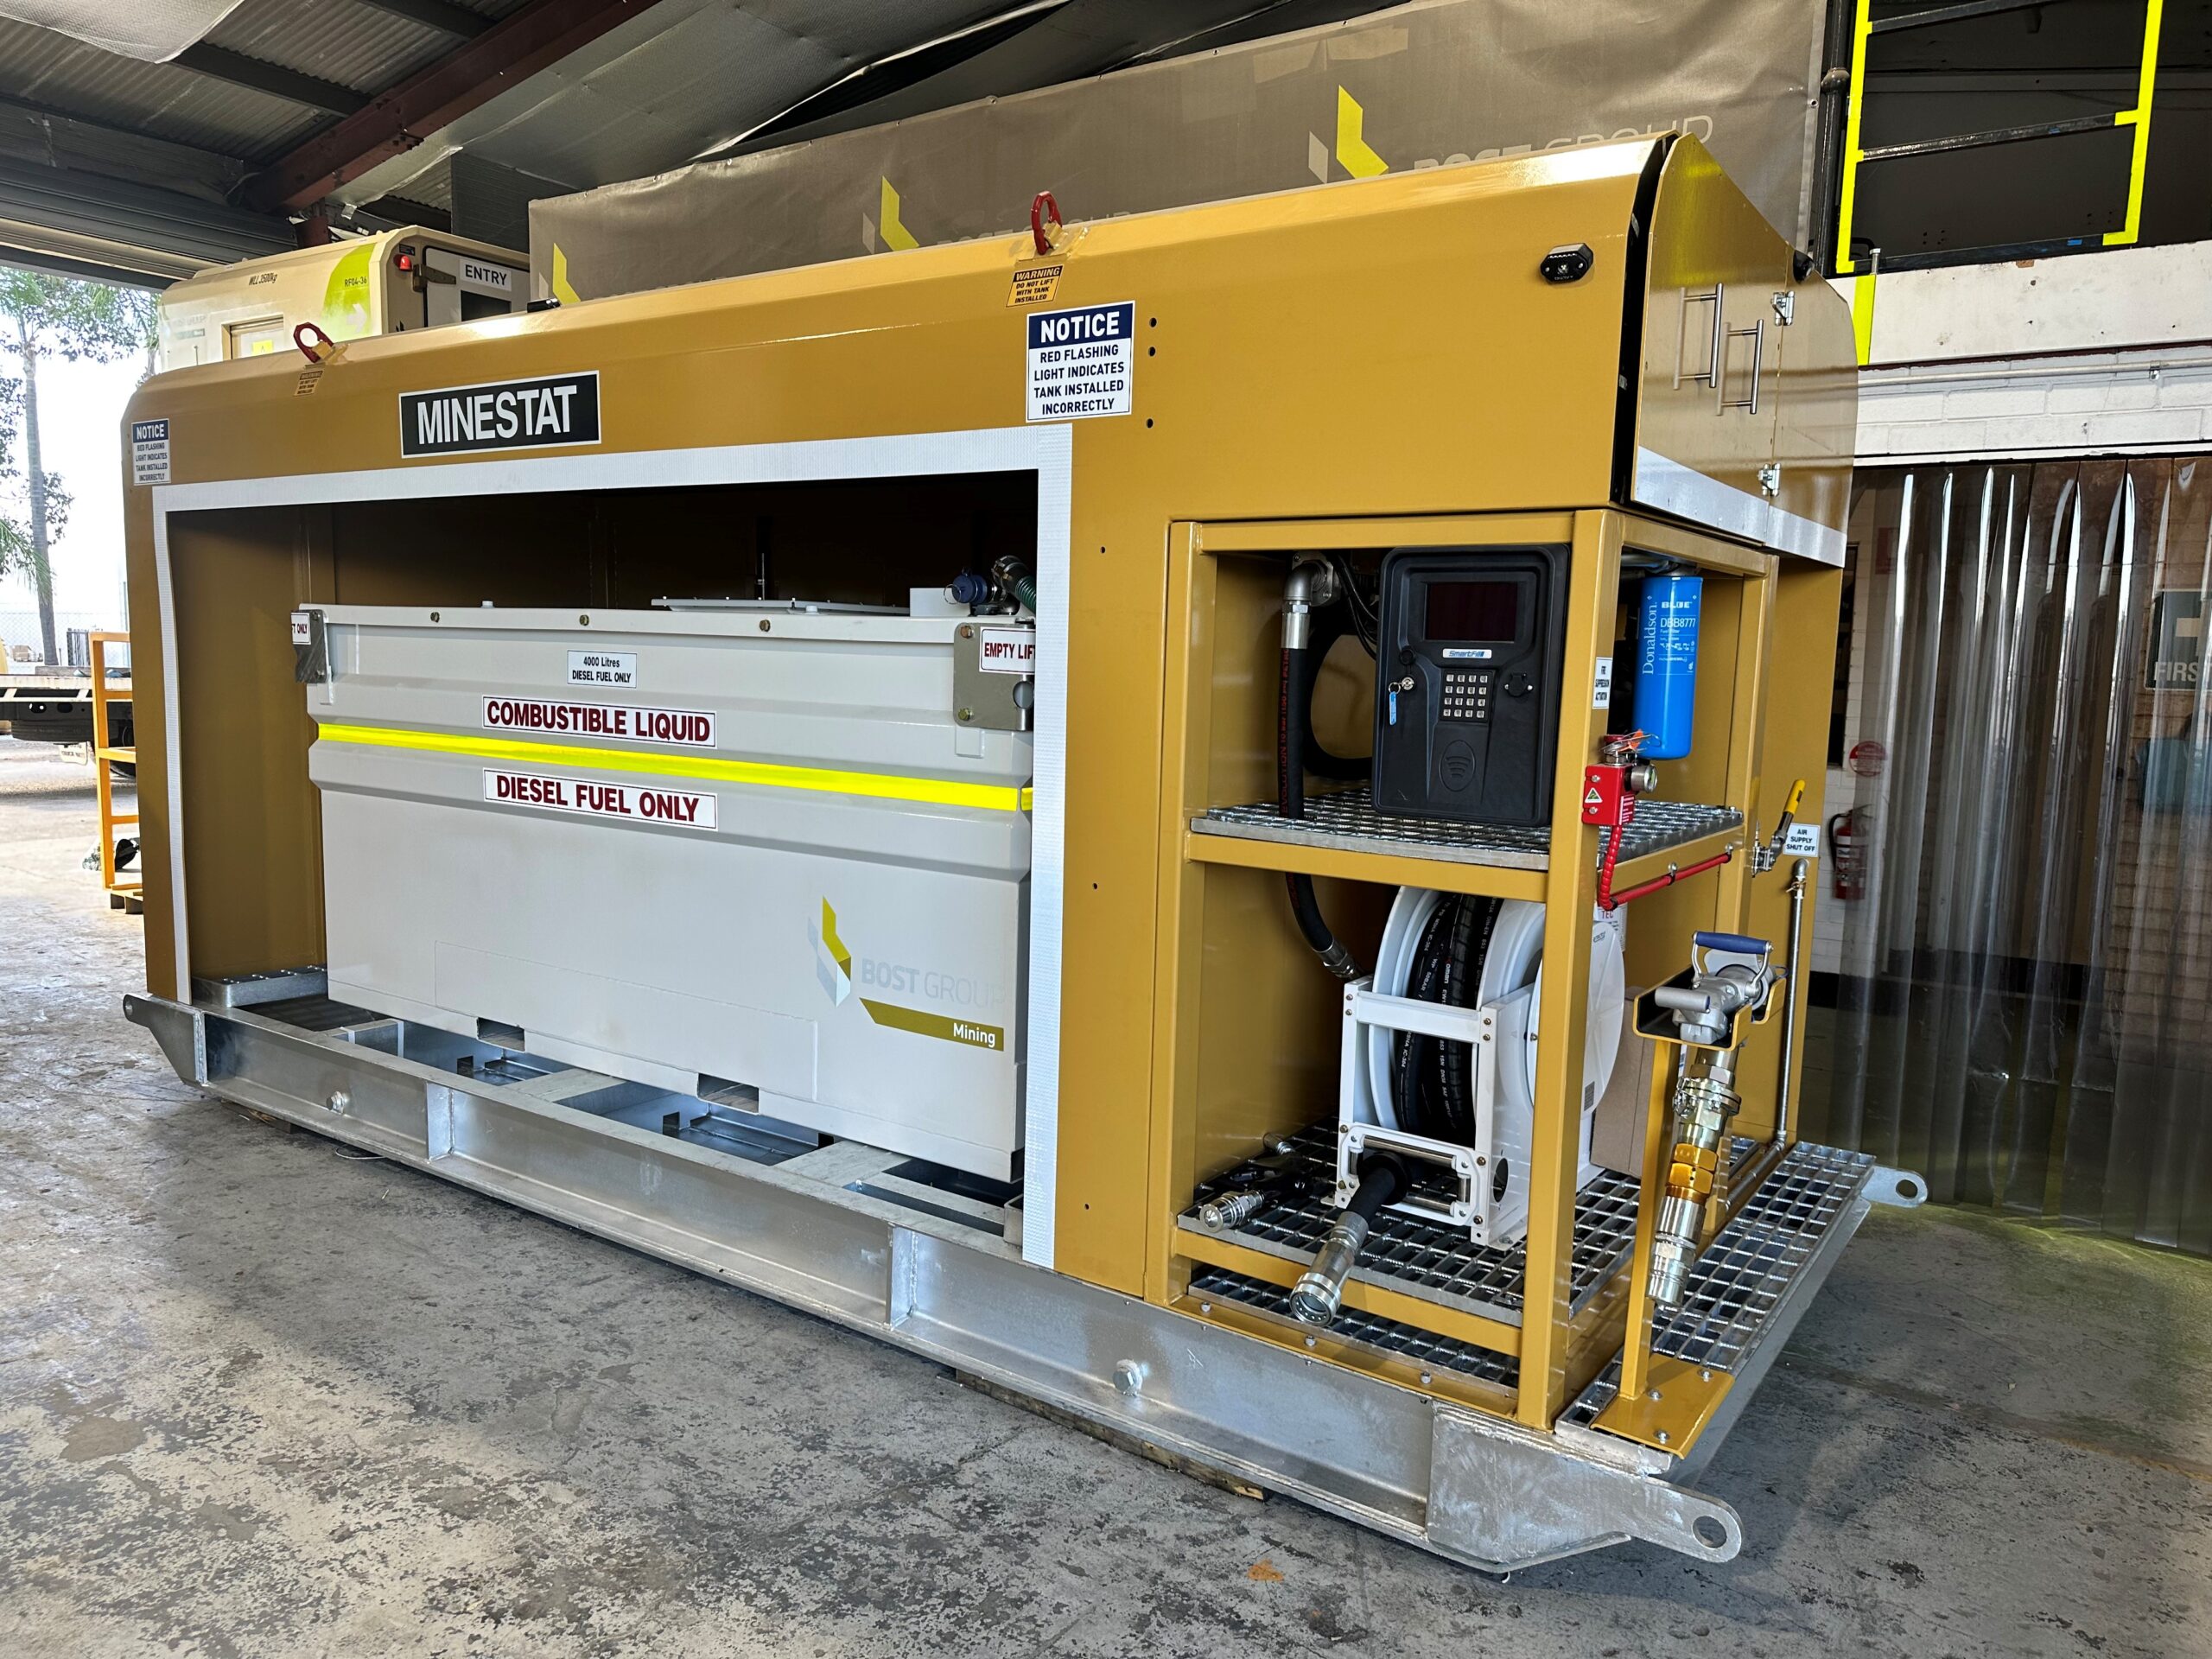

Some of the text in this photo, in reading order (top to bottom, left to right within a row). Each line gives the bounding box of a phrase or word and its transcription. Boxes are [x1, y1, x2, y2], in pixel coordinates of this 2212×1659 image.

[465, 264, 507, 286] ENTRY
[1015, 267, 1061, 282] WARNING
[1014, 294, 1047, 303] INSTALLED
[1040, 311, 1120, 343] NOTICE
[1040, 344, 1119, 363] RED FLASHING
[1034, 361, 1124, 381] LIGHT INDICATES
[1033, 379, 1124, 398] TANK INSTALLED
[417, 385, 577, 445] MINESTAT
[1042, 398, 1115, 415] INCORRECTLY
[137, 423, 164, 440] NOTICE
[145, 442, 165, 451] FLASHING
[147, 462, 168, 471] INSTALLED
[139, 473, 165, 481] INCORRECTLY
[297, 624, 308, 634] ONLY
[1660, 618, 1696, 628] DBB8777
[984, 642, 1015, 658] EMPTY
[583, 657, 620, 668] 4000 Litres
[572, 670, 632, 683] DIESEL FUEL ONLY
[2154, 661, 2212, 682] FIRS
[487, 701, 710, 742] COMBUSTIBLE LIQUID
[497, 775, 700, 822] DIESEL FUEL ONLY
[861, 957, 920, 994] BOST
[953, 1022, 996, 1048] Mining
